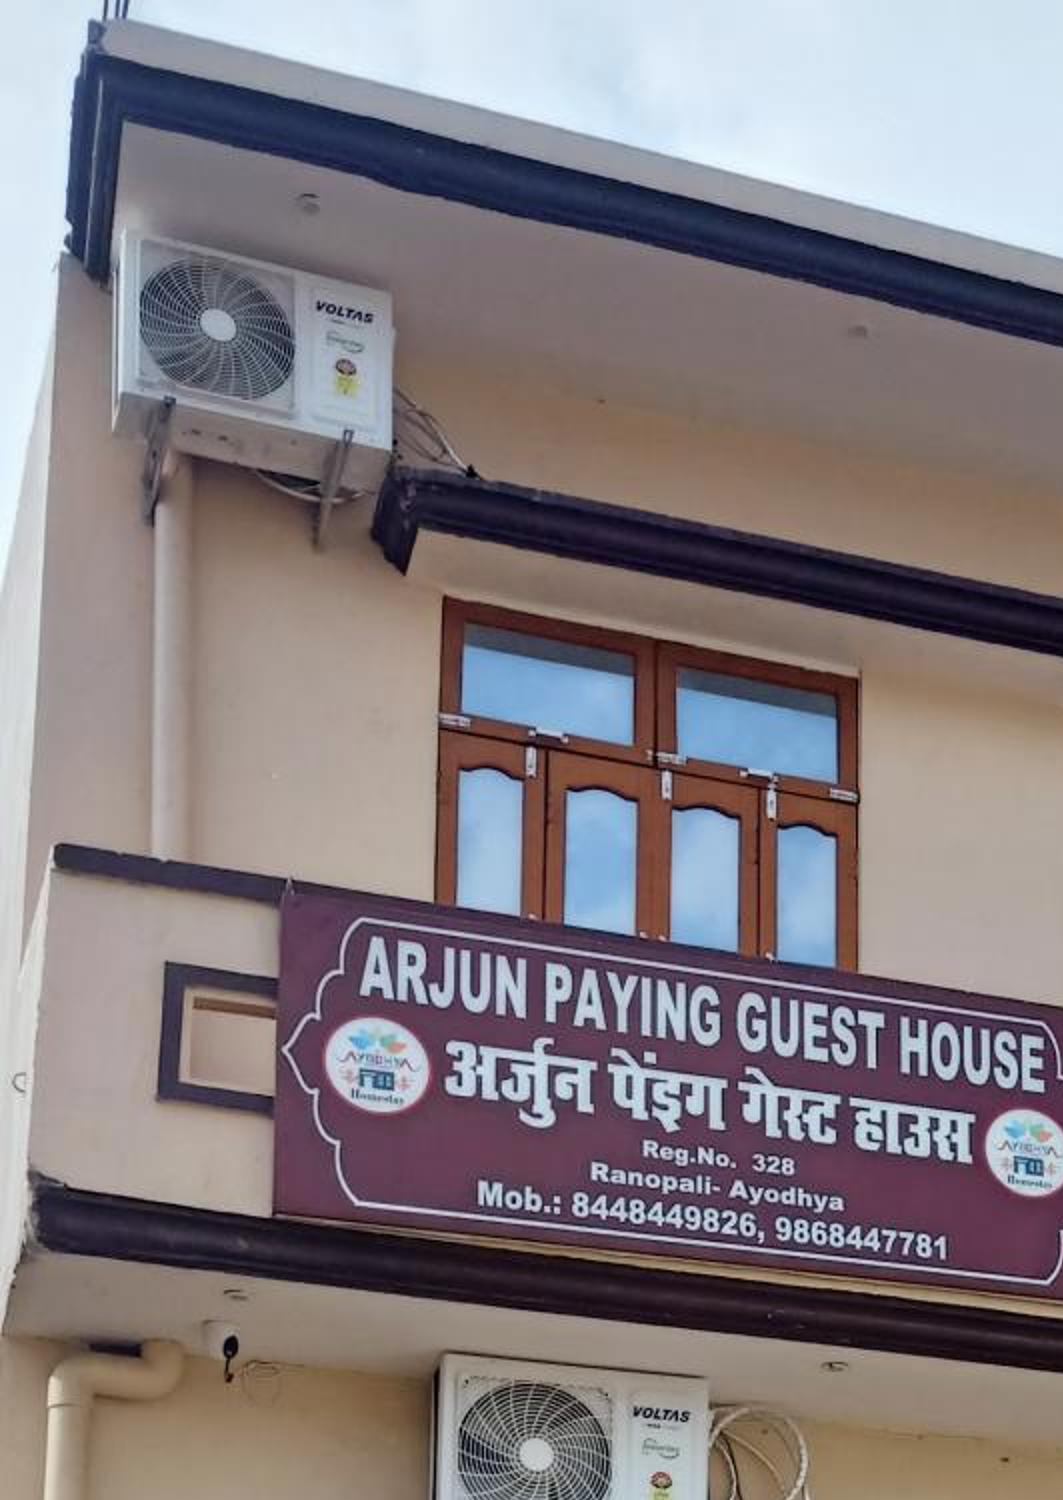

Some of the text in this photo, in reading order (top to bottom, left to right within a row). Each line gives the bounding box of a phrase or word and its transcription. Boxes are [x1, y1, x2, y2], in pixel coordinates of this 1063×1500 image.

[316, 300, 374, 324] VOLTAS
[359, 936, 1046, 1093] ARJUN PAYING GUEST HOUSE
[445, 1037, 598, 1129] अर्जुन
[738, 1066, 841, 1145] गेस्ट
[849, 1096, 976, 1164] हाउस
[643, 1140, 796, 1176] Reg.No. 328
[590, 1161, 845, 1213] Ranopali- Ayodhya
[477, 1180, 949, 1260] Mob.: 8448449826, 9868447781
[632, 1406, 691, 1423] VOLTAS
